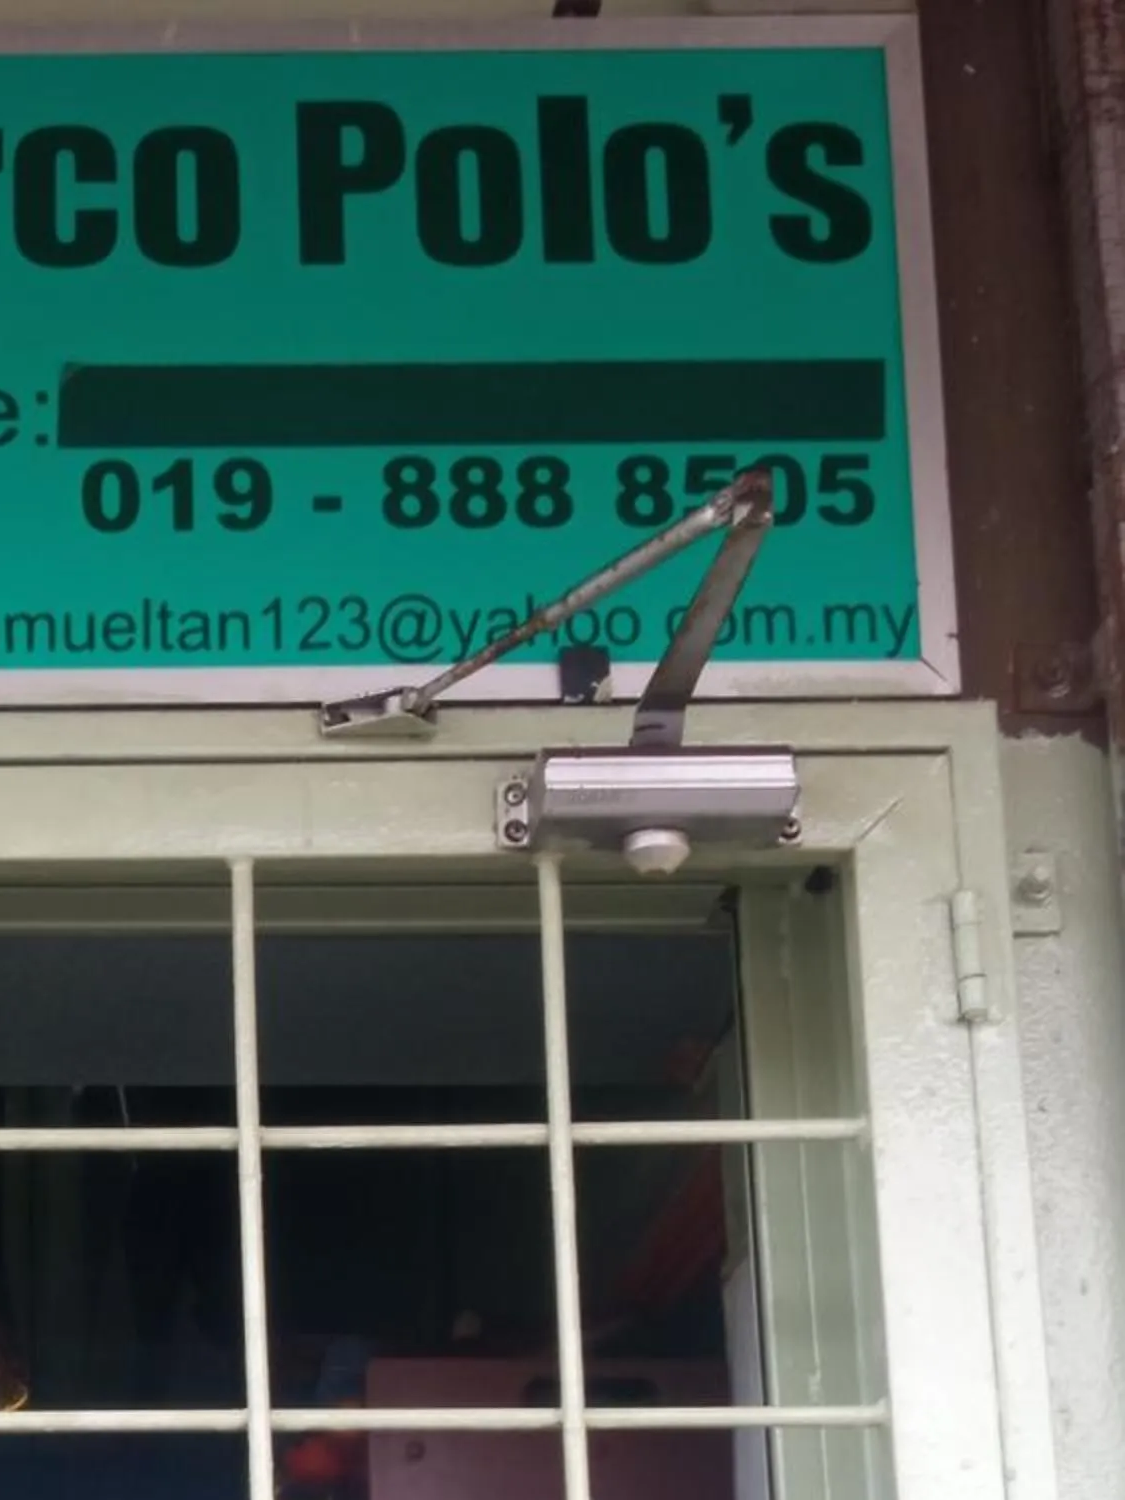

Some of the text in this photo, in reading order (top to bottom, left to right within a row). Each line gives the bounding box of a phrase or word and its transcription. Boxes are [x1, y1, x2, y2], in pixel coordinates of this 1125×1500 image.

[294, 92, 874, 268] Polo's
[80, 457, 273, 533] 019
[381, 454, 573, 529] 888
